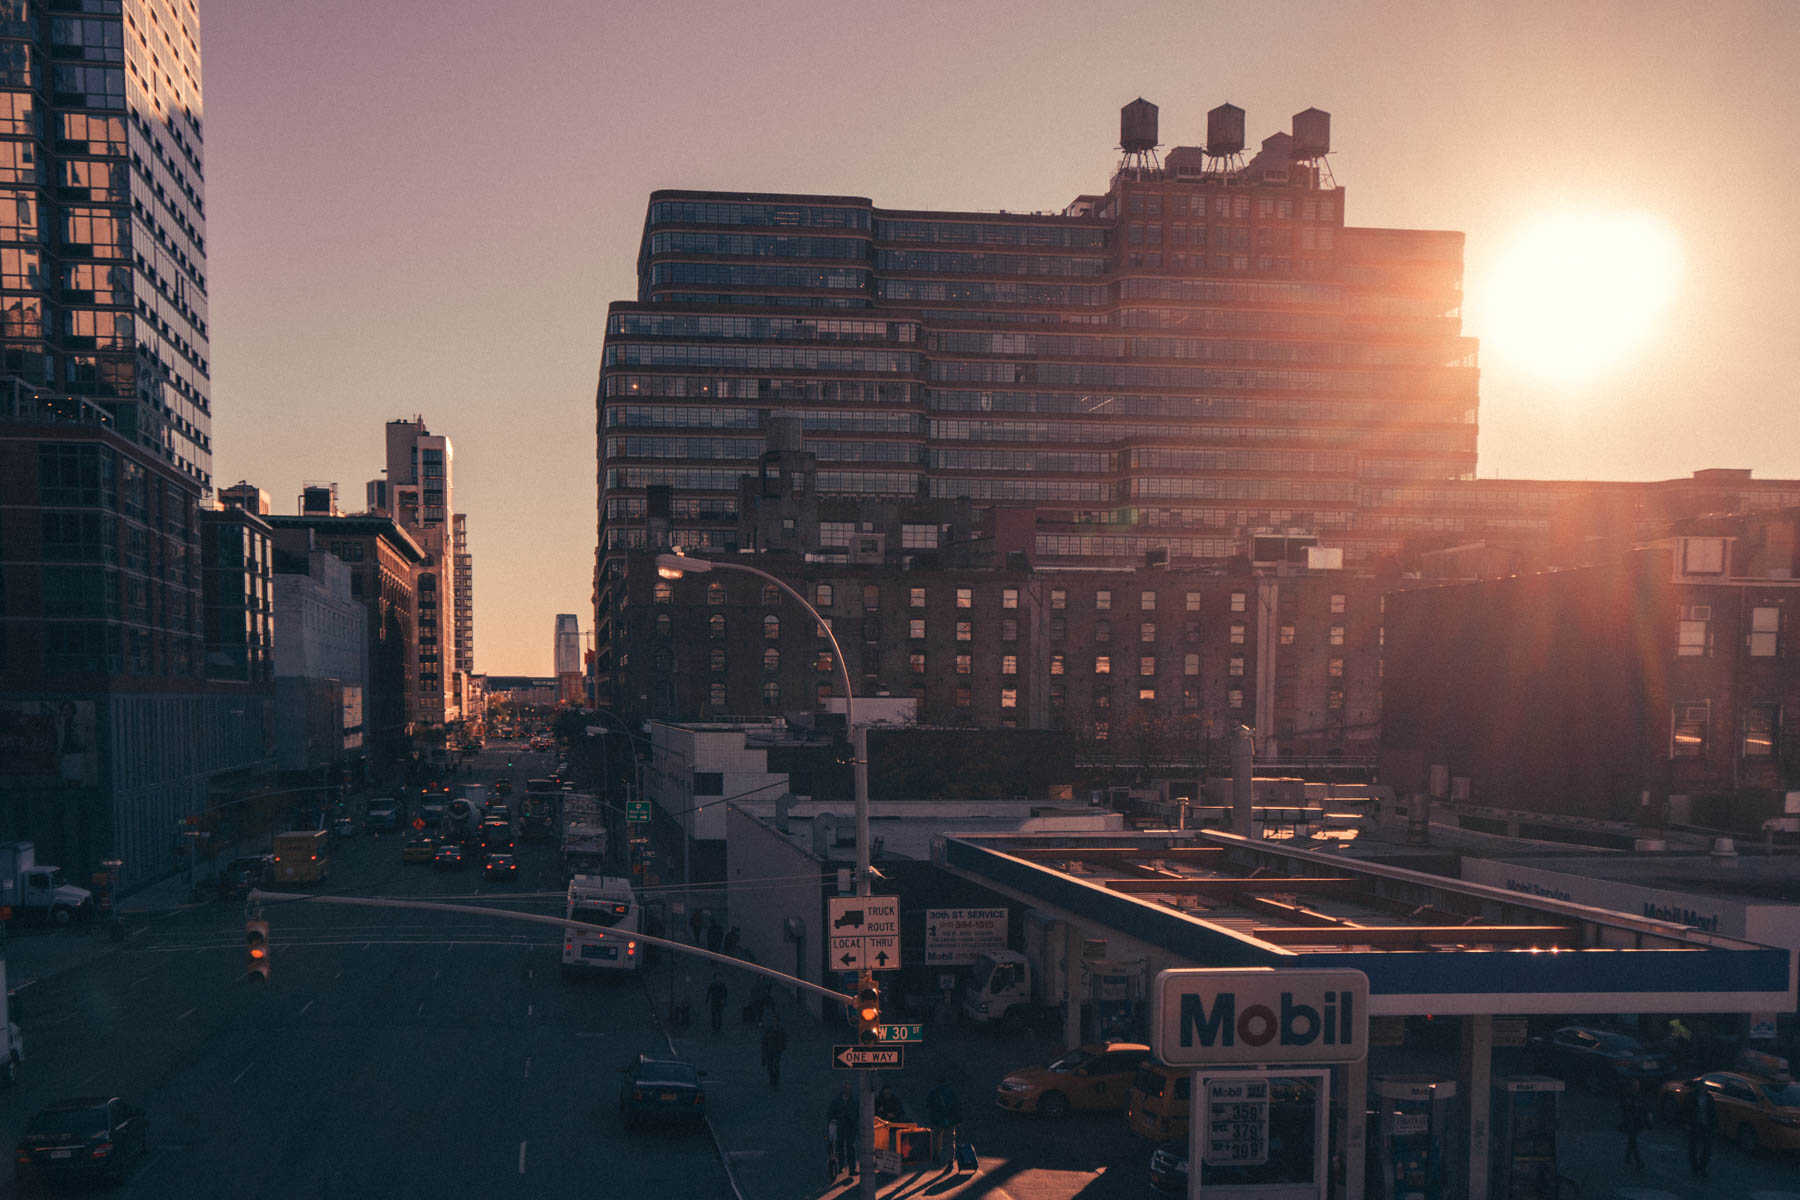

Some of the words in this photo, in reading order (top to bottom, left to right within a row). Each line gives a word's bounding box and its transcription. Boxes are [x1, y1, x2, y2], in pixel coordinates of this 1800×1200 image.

[868, 907, 895, 916] TRUCK
[967, 911, 1005, 919] SERVICE
[868, 922, 895, 931] ROUTE
[833, 939, 861, 949] LOCAL
[870, 938, 893, 947] THRU
[927, 952, 953, 961] Mobil
[1180, 991, 1353, 1047] Mobil
[879, 1026, 888, 1040] W
[892, 1026, 908, 1040] 30
[846, 1053, 867, 1062] ONE
[872, 1053, 893, 1061] WAY
[1212, 1087, 1242, 1097] Mobil
